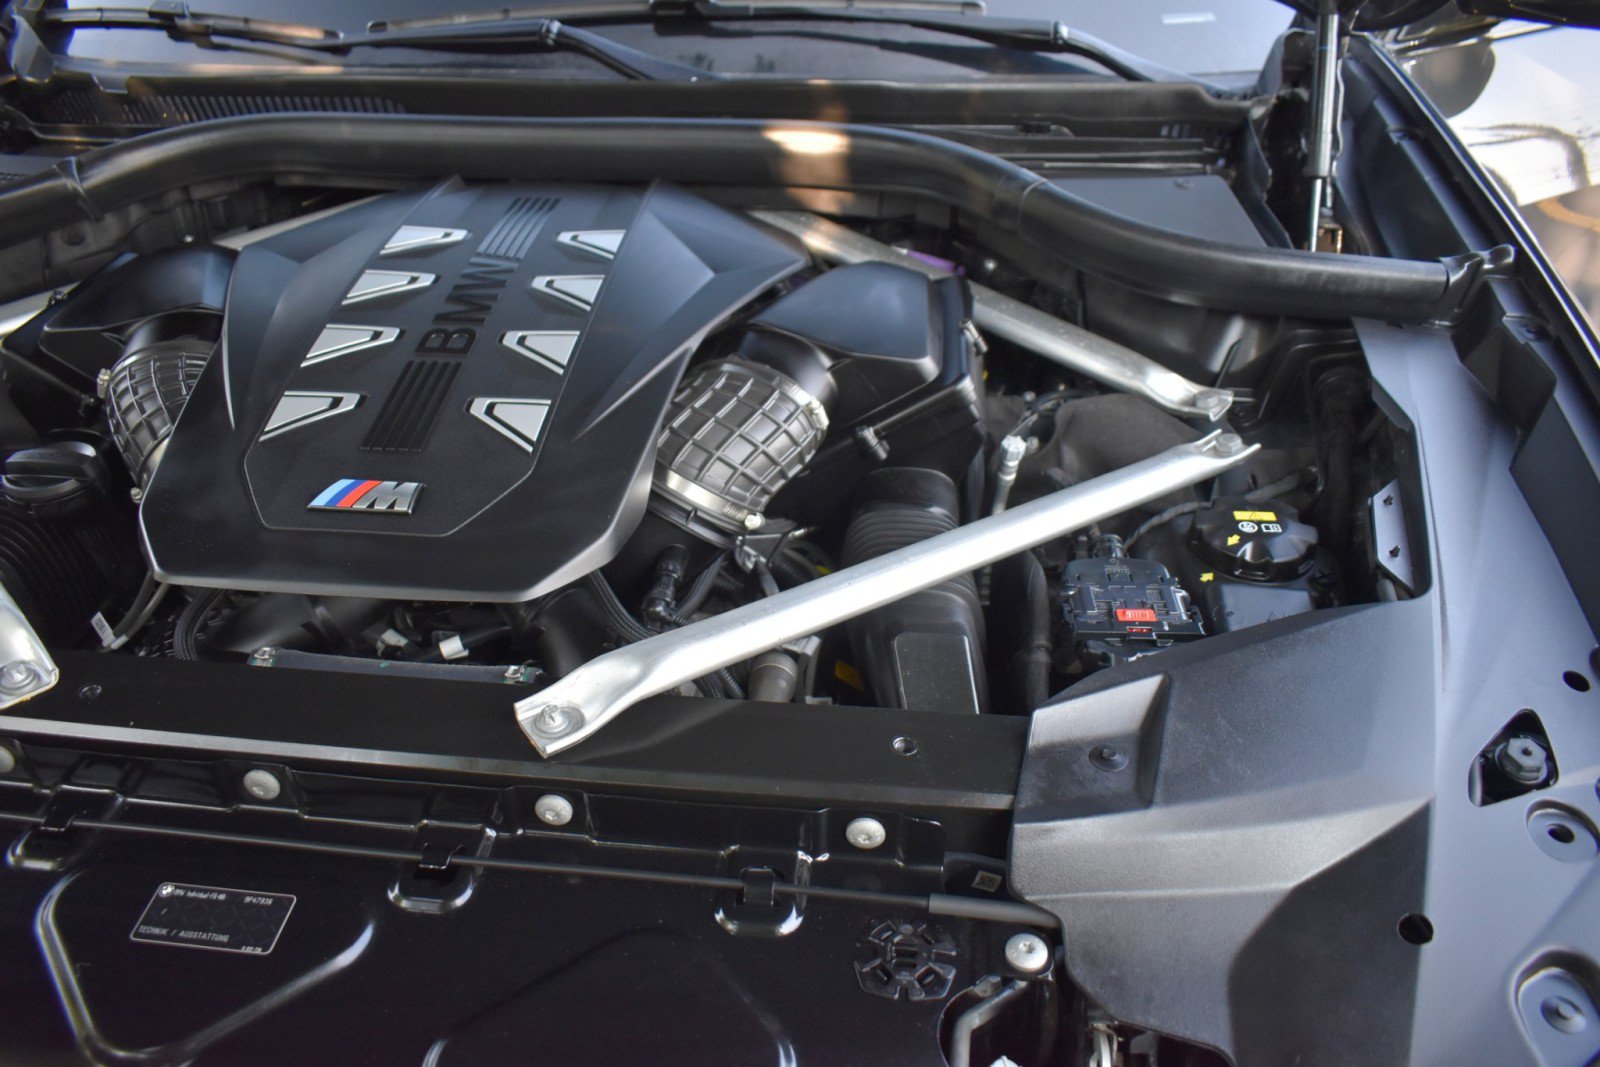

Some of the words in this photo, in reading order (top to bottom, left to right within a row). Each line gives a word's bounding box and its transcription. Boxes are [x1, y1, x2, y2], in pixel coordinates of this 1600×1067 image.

[414, 256, 519, 355] BMW
[352, 481, 420, 511] M
[139, 925, 169, 936] TECHNIK
[178, 930, 230, 943] AUSSTATTUNG
